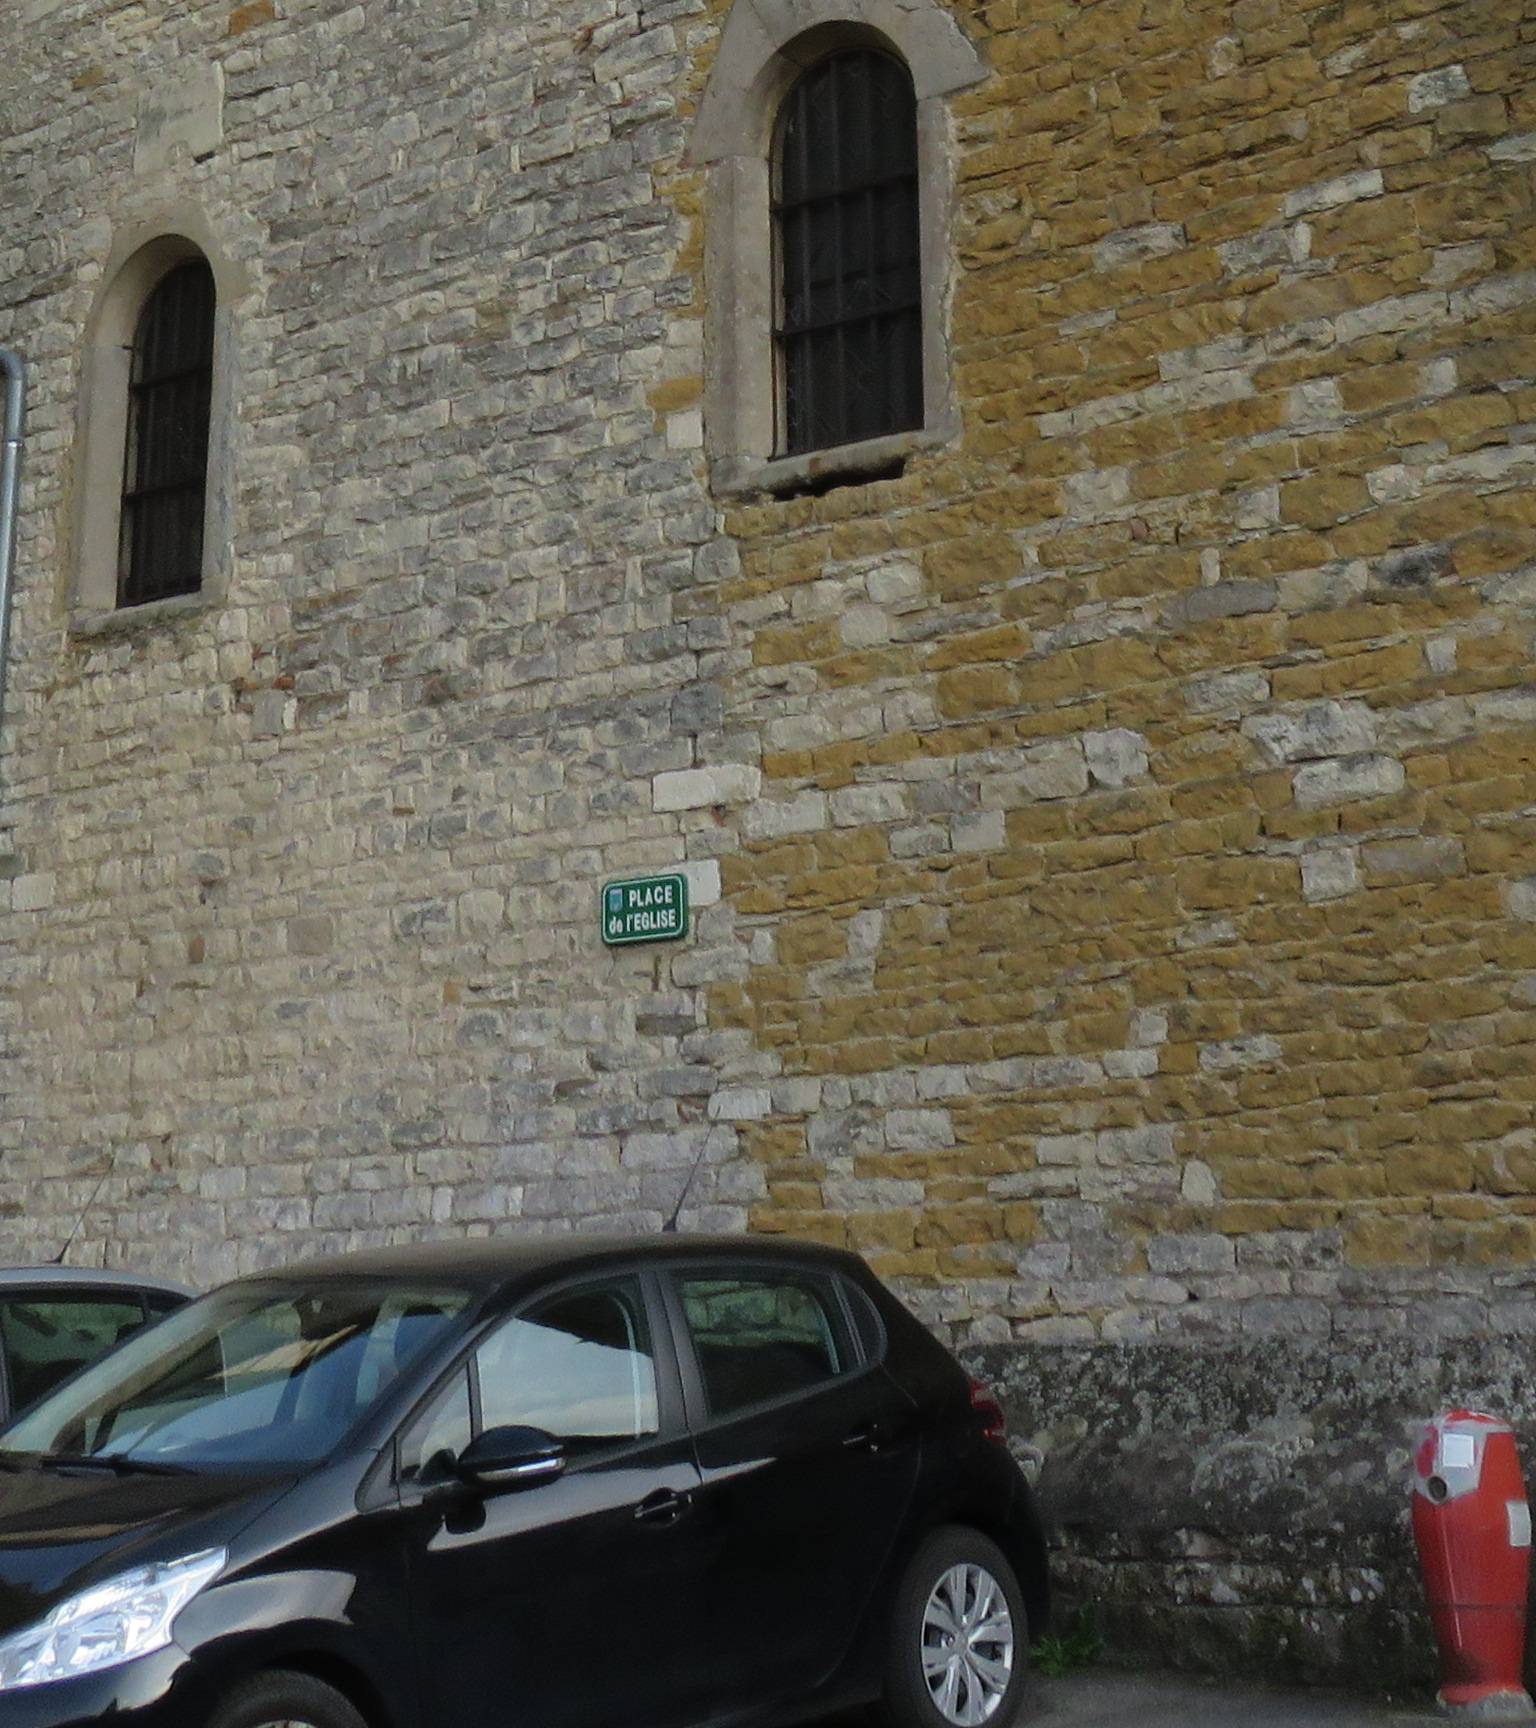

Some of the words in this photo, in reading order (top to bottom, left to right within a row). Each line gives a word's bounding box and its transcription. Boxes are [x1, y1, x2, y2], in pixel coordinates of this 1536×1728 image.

[629, 885, 673, 907] PLACE
[609, 916, 624, 934] de
[626, 908, 676, 932] l'EGLISE
